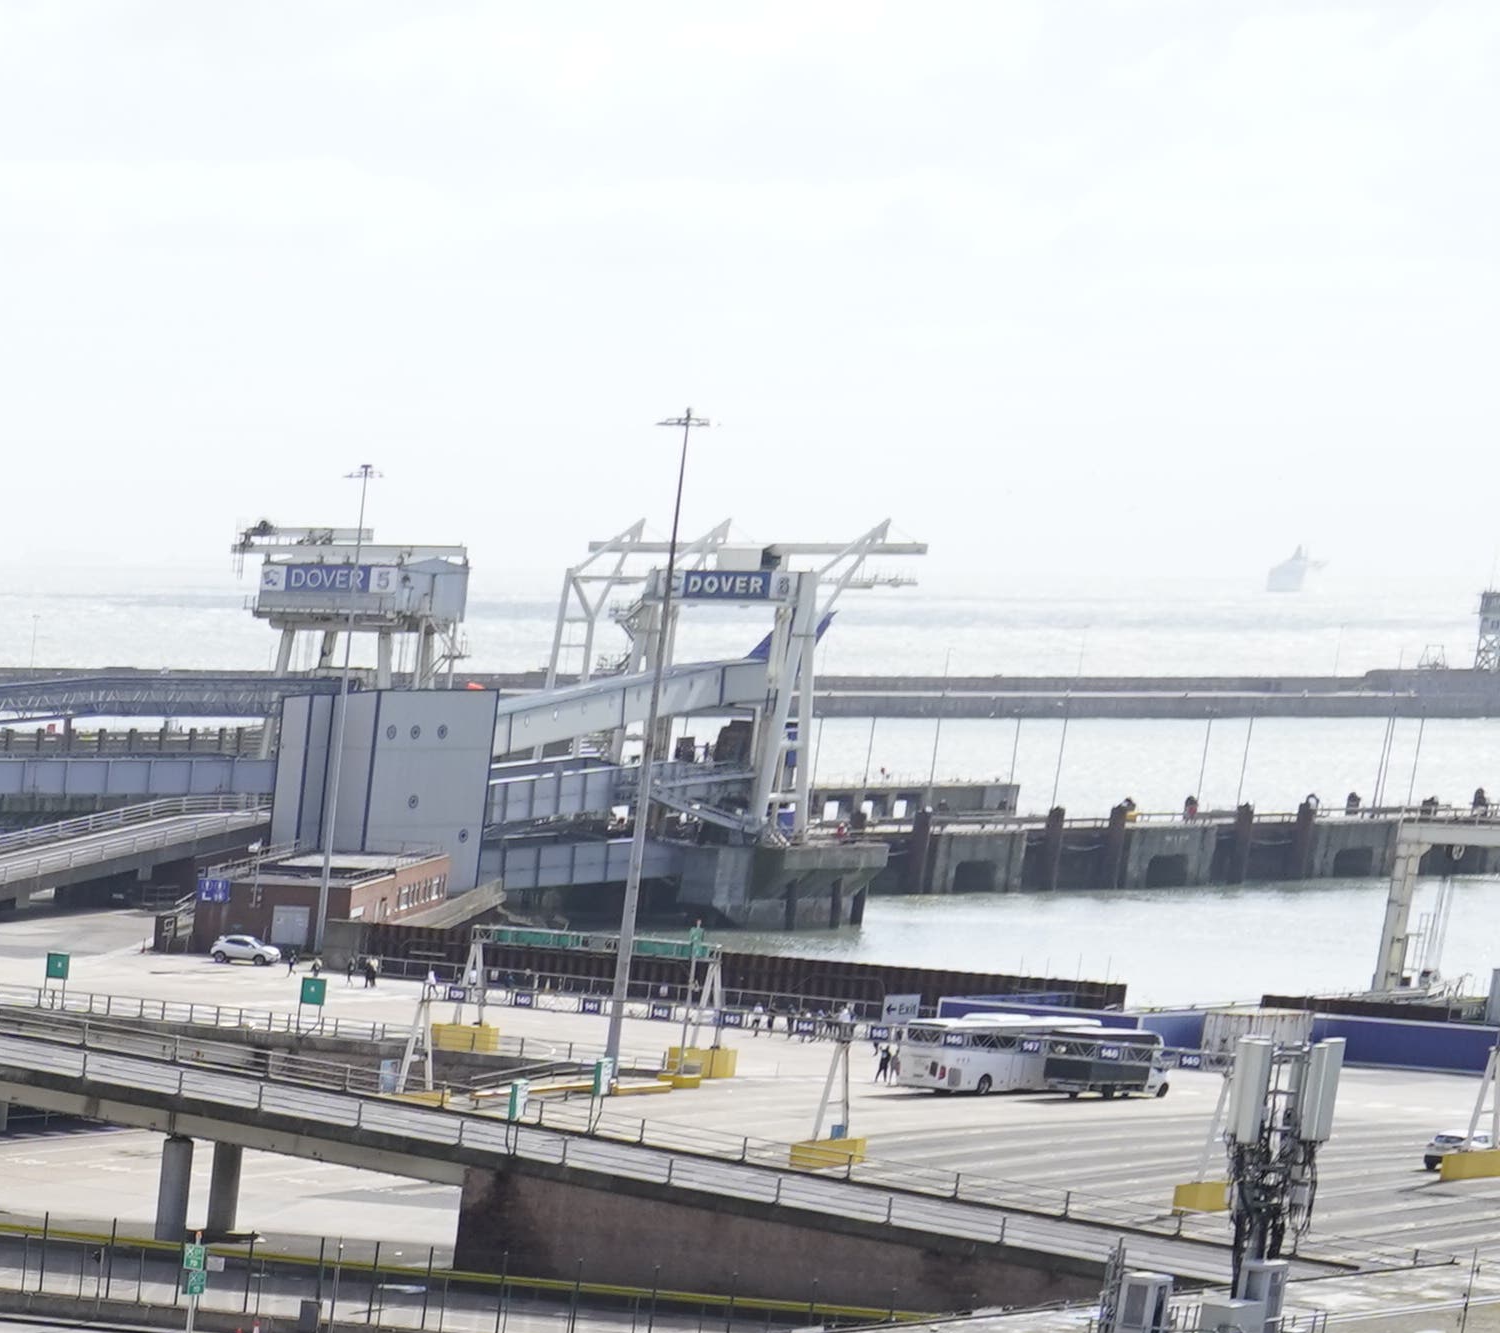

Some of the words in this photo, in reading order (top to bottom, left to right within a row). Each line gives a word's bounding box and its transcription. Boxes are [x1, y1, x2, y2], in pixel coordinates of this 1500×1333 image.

[291, 568, 364, 589] DOVER
[376, 570, 390, 590] 5
[688, 576, 764, 593] DOVER
[897, 1002, 916, 1015] Exit
[1022, 1041, 1040, 1051] 147
[1101, 1048, 1118, 1059] 148
